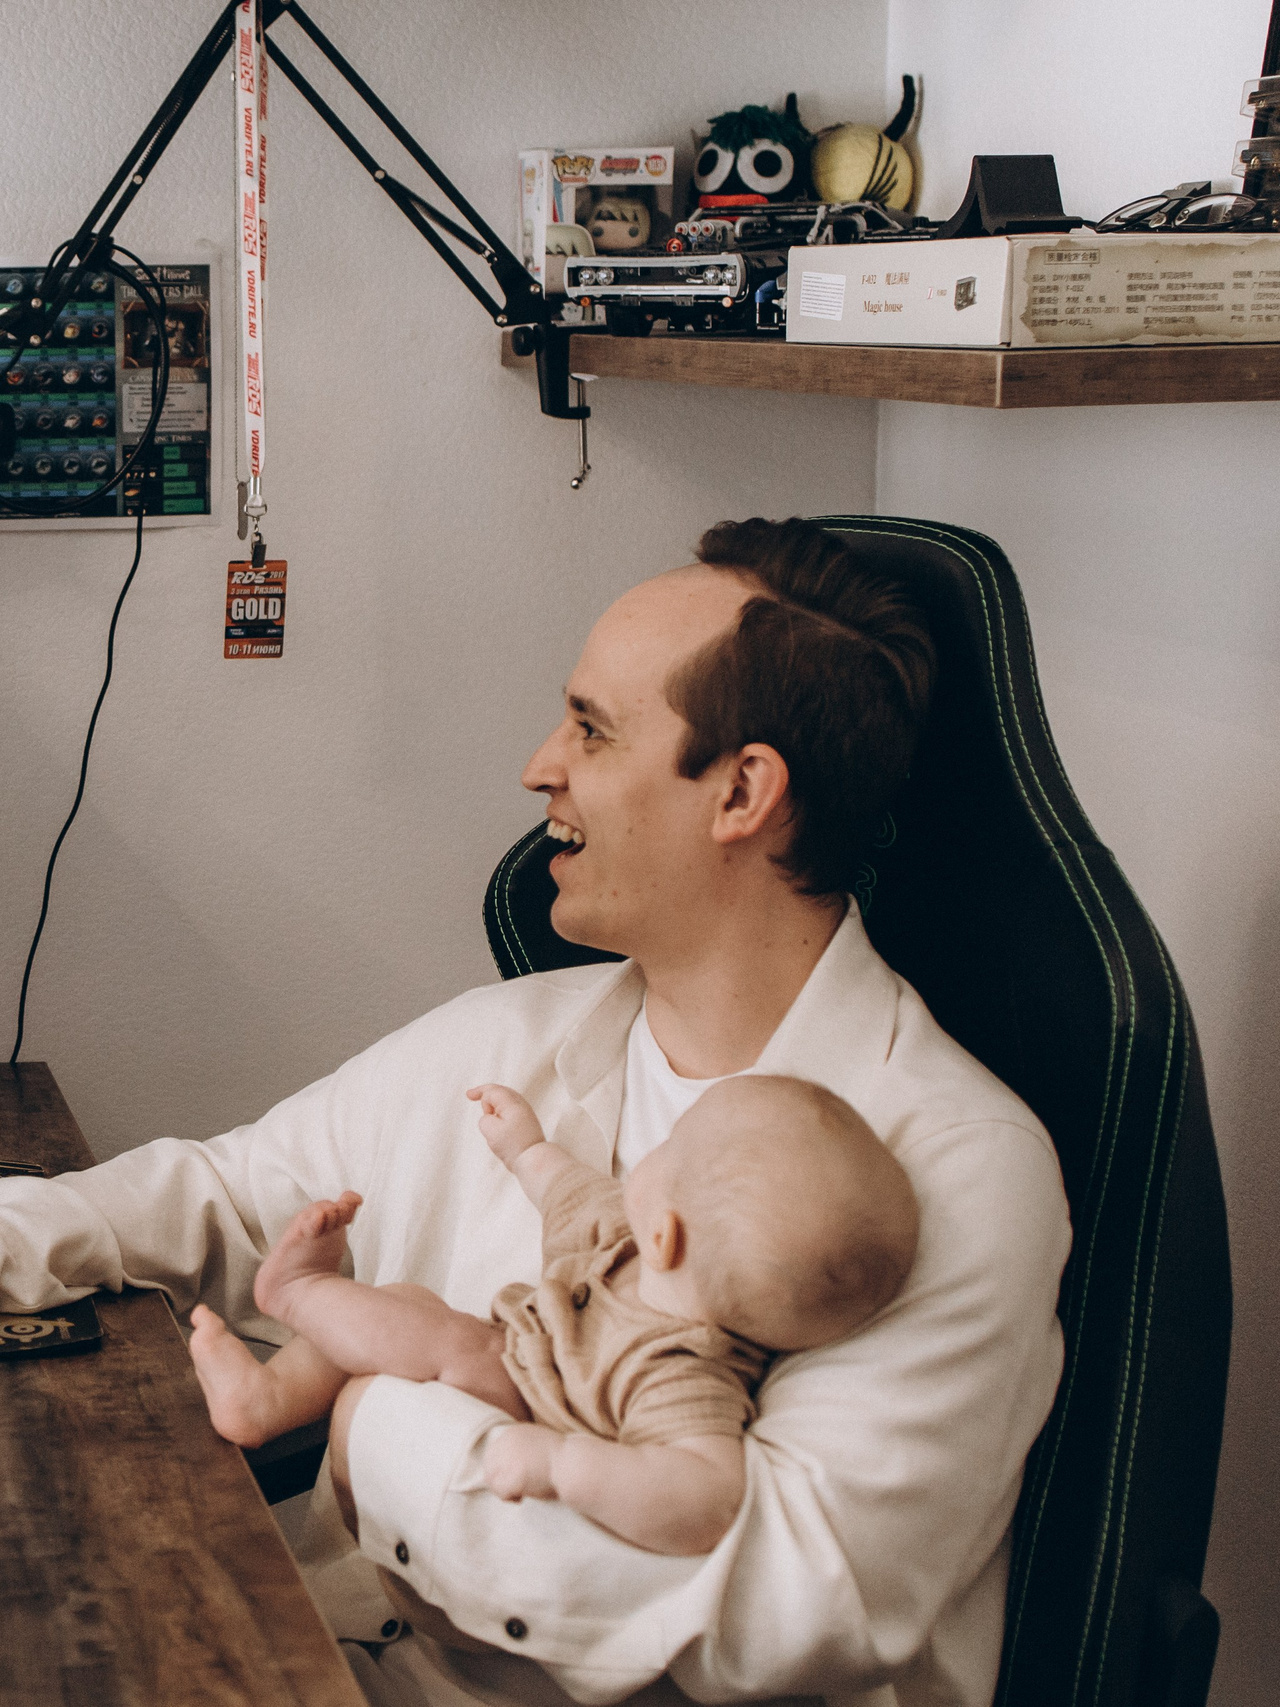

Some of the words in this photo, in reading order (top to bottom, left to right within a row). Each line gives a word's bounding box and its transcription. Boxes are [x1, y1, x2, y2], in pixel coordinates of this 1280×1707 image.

[244, 107, 254, 178] VDRIFTE.RU
[247, 269, 257, 339] VDRIFTE.RU
[863, 300, 883, 315] Magic
[883, 301, 904, 313] house
[231, 571, 269, 585] RDS
[231, 597, 282, 620] GOLD
